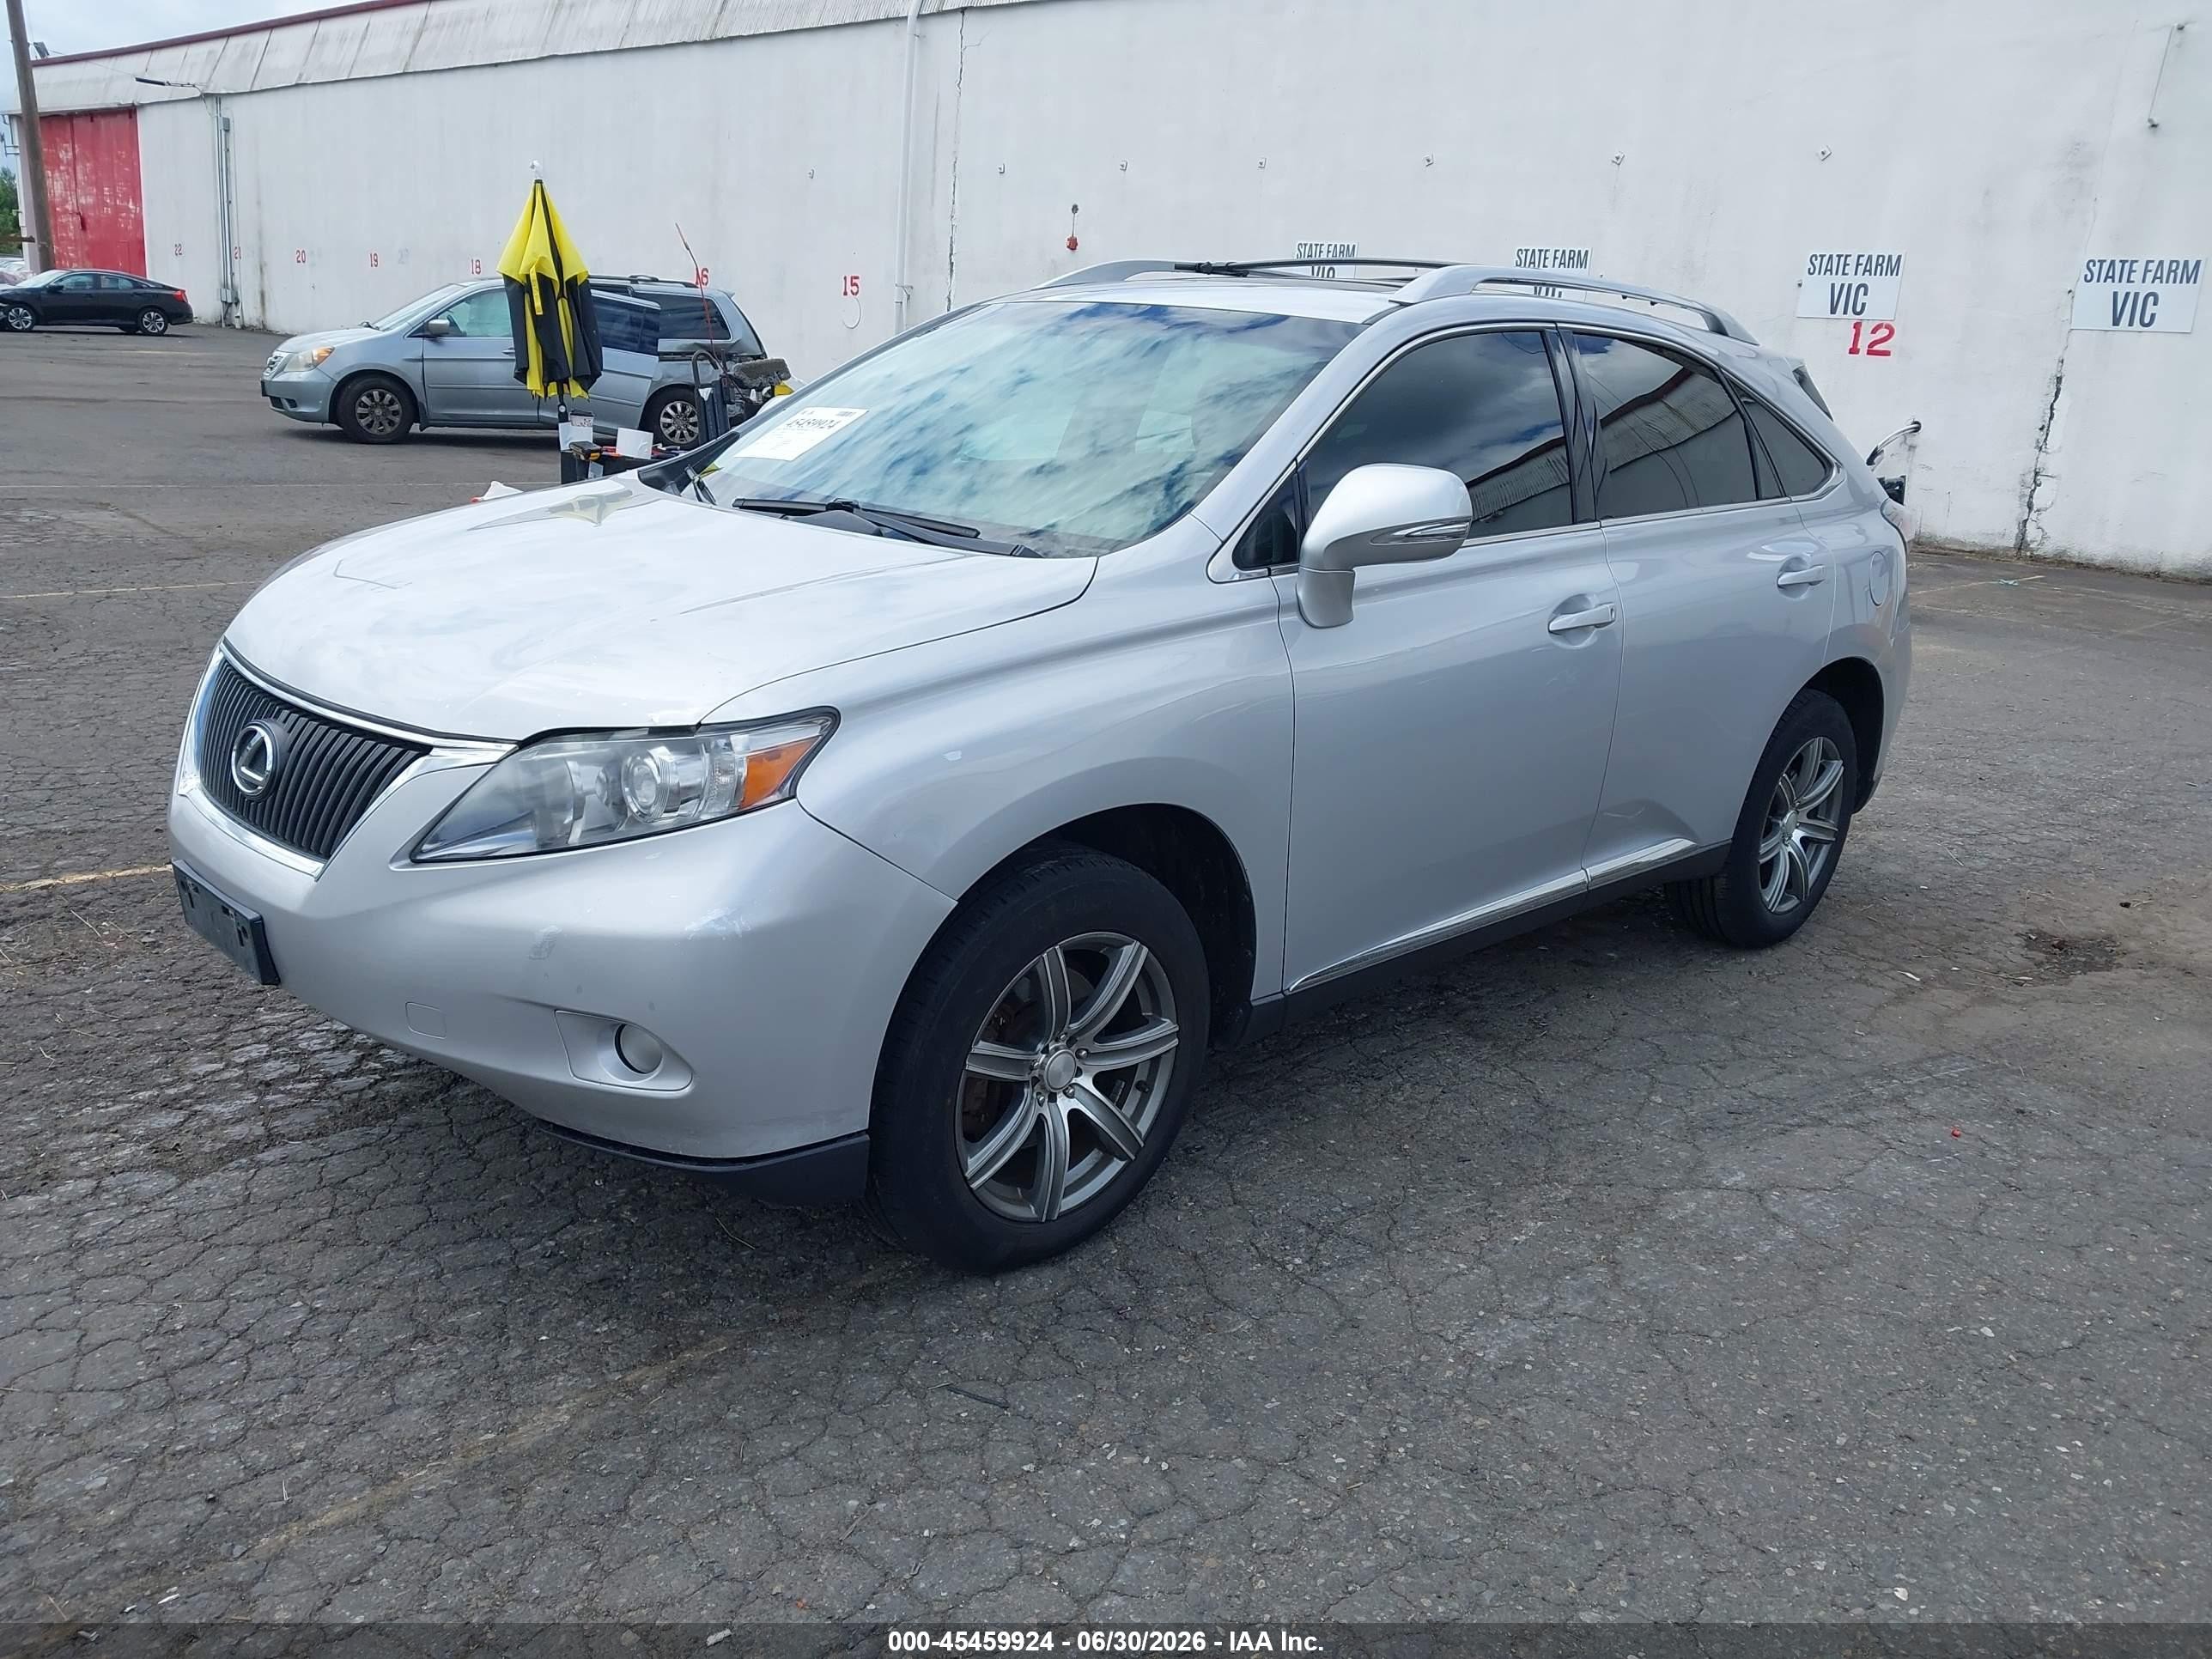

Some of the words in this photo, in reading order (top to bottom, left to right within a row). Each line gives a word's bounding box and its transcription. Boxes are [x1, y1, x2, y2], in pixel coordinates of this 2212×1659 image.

[295, 250, 307, 264] 20
[369, 252, 379, 268] 19
[1296, 243, 1324, 259] STATE
[1327, 244, 1356, 258] FARM
[1516, 248, 1550, 268] STATE
[1552, 249, 1589, 270] FARM
[471, 259, 482, 275] 18
[1808, 253, 1852, 276] STATE
[1855, 254, 1902, 276] FARM
[2084, 259, 2138, 283] STATE
[2142, 259, 2202, 284] FARM
[842, 275, 860, 296] 15
[1830, 283, 1869, 316] VIC
[2112, 291, 2160, 327] VIC
[1848, 321, 1896, 356] 12
